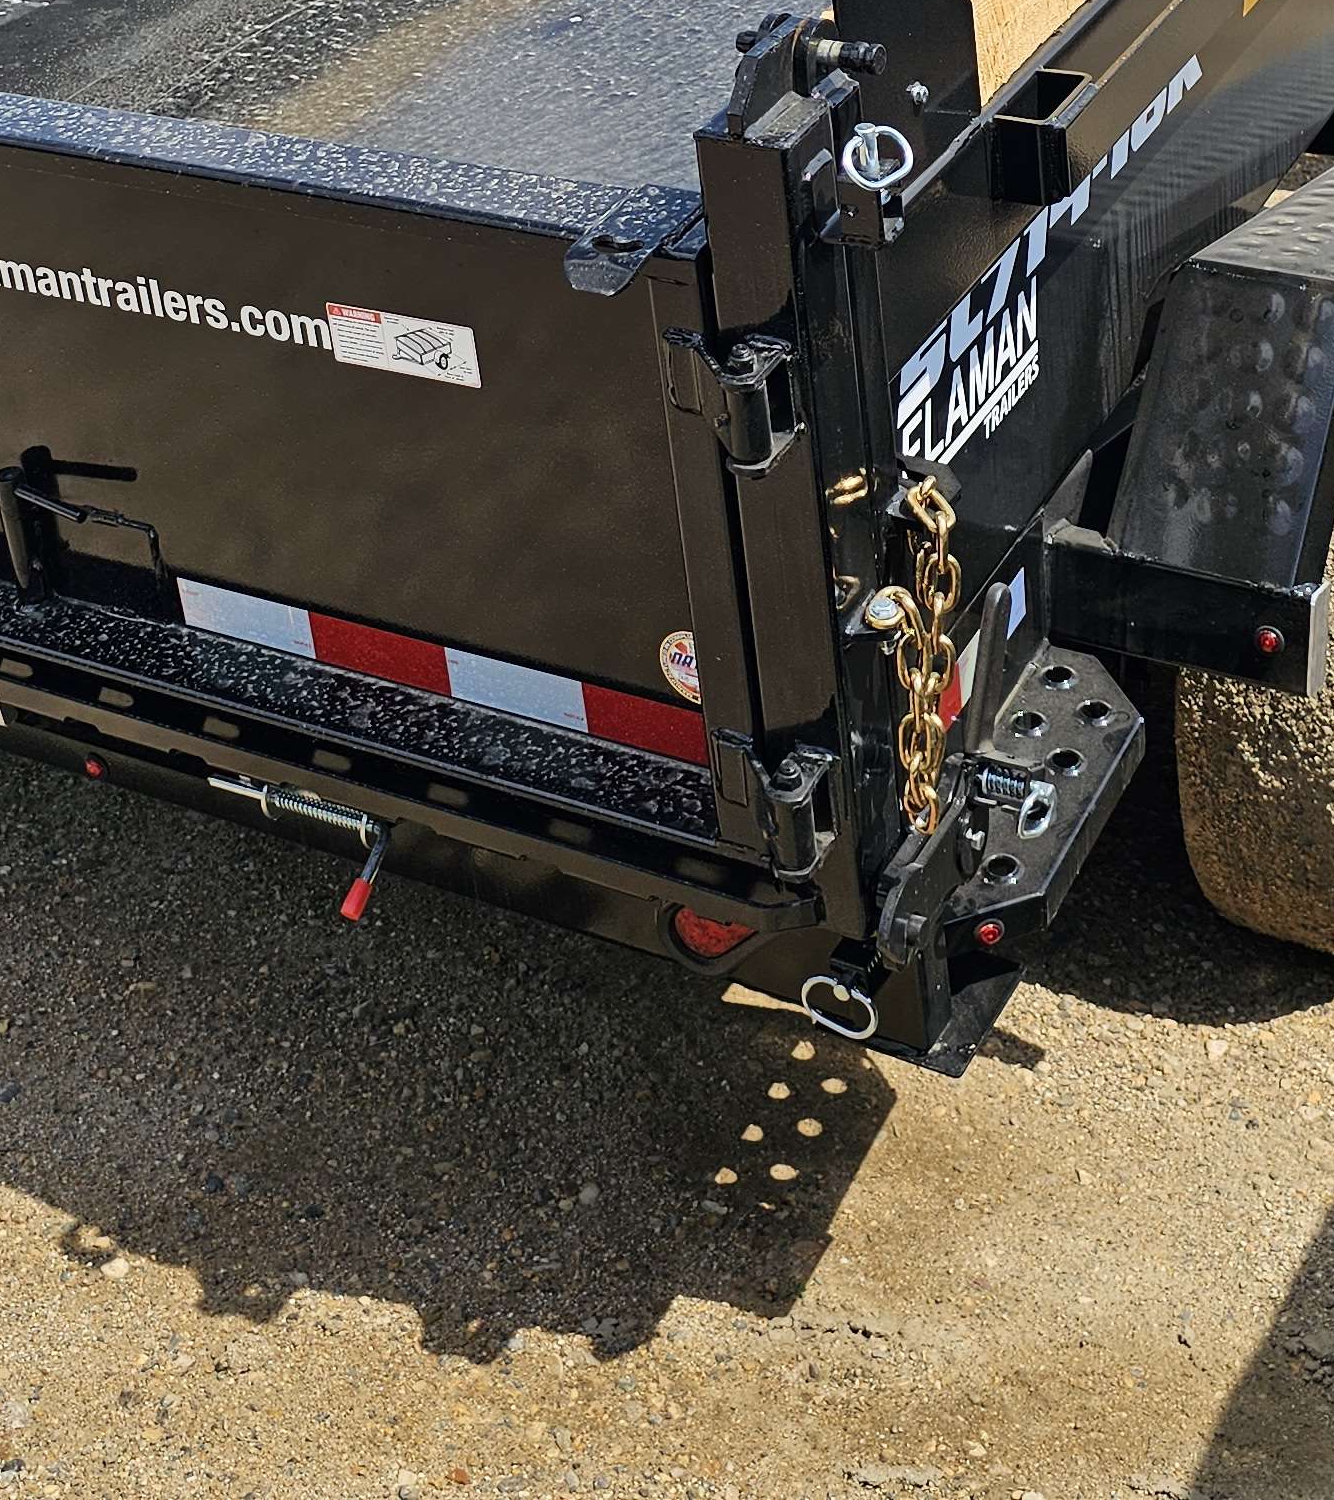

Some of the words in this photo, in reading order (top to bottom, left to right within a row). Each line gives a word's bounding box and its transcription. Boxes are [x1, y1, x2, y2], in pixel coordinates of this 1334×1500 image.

[341, 308, 376, 322] WARNING
[901, 275, 1038, 462] FLAMAN
[983, 354, 1040, 440] TRAILERS
